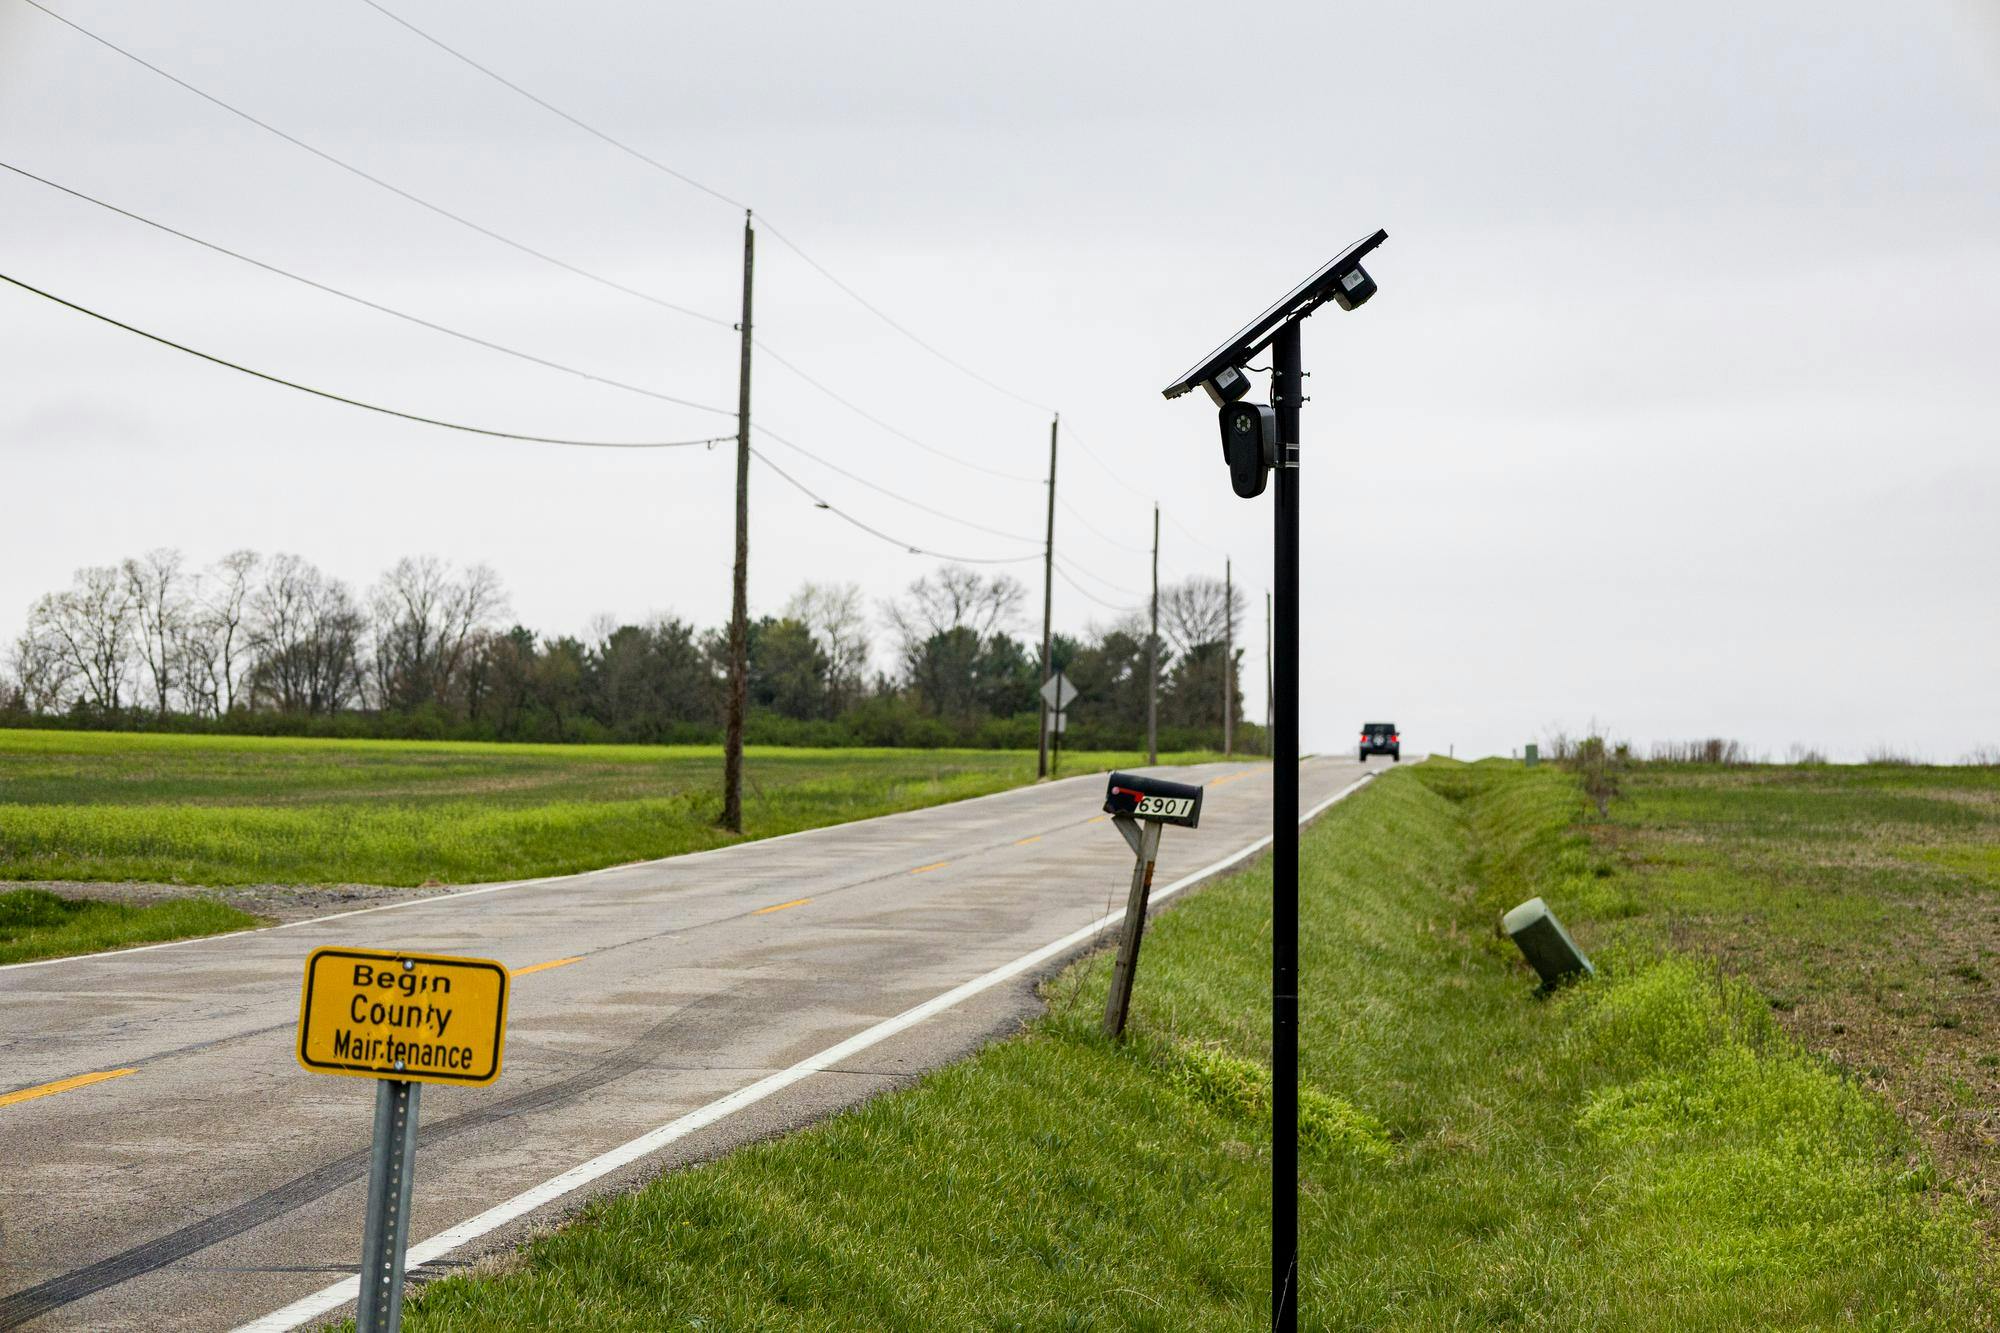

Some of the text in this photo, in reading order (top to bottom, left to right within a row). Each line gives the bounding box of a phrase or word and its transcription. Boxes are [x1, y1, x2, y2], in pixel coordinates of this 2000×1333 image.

[1139, 797, 1188, 815] 6901
[353, 965, 451, 997] Begin
[351, 994, 452, 1038] County
[334, 1029, 473, 1070] Maintenance
